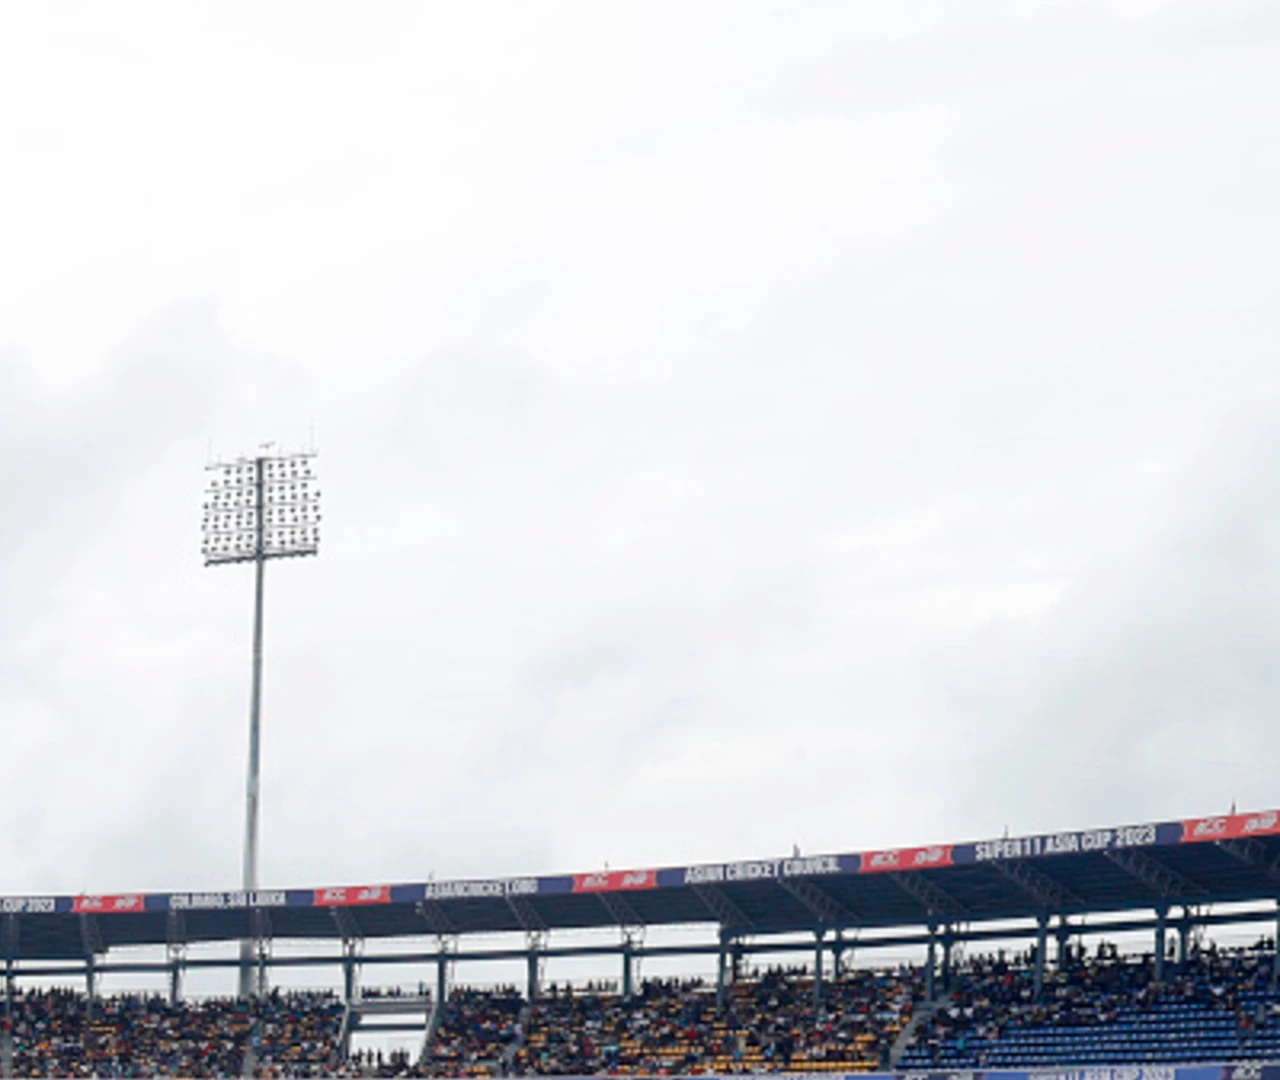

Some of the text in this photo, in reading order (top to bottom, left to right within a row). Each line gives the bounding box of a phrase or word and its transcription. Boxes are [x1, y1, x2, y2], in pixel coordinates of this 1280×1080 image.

[1044, 837, 1079, 854] ASIA
[1080, 832, 1113, 851] CUP
[1115, 827, 1156, 846] 2023
[684, 856, 841, 884] ASIAN CRICKET COUNCIL
